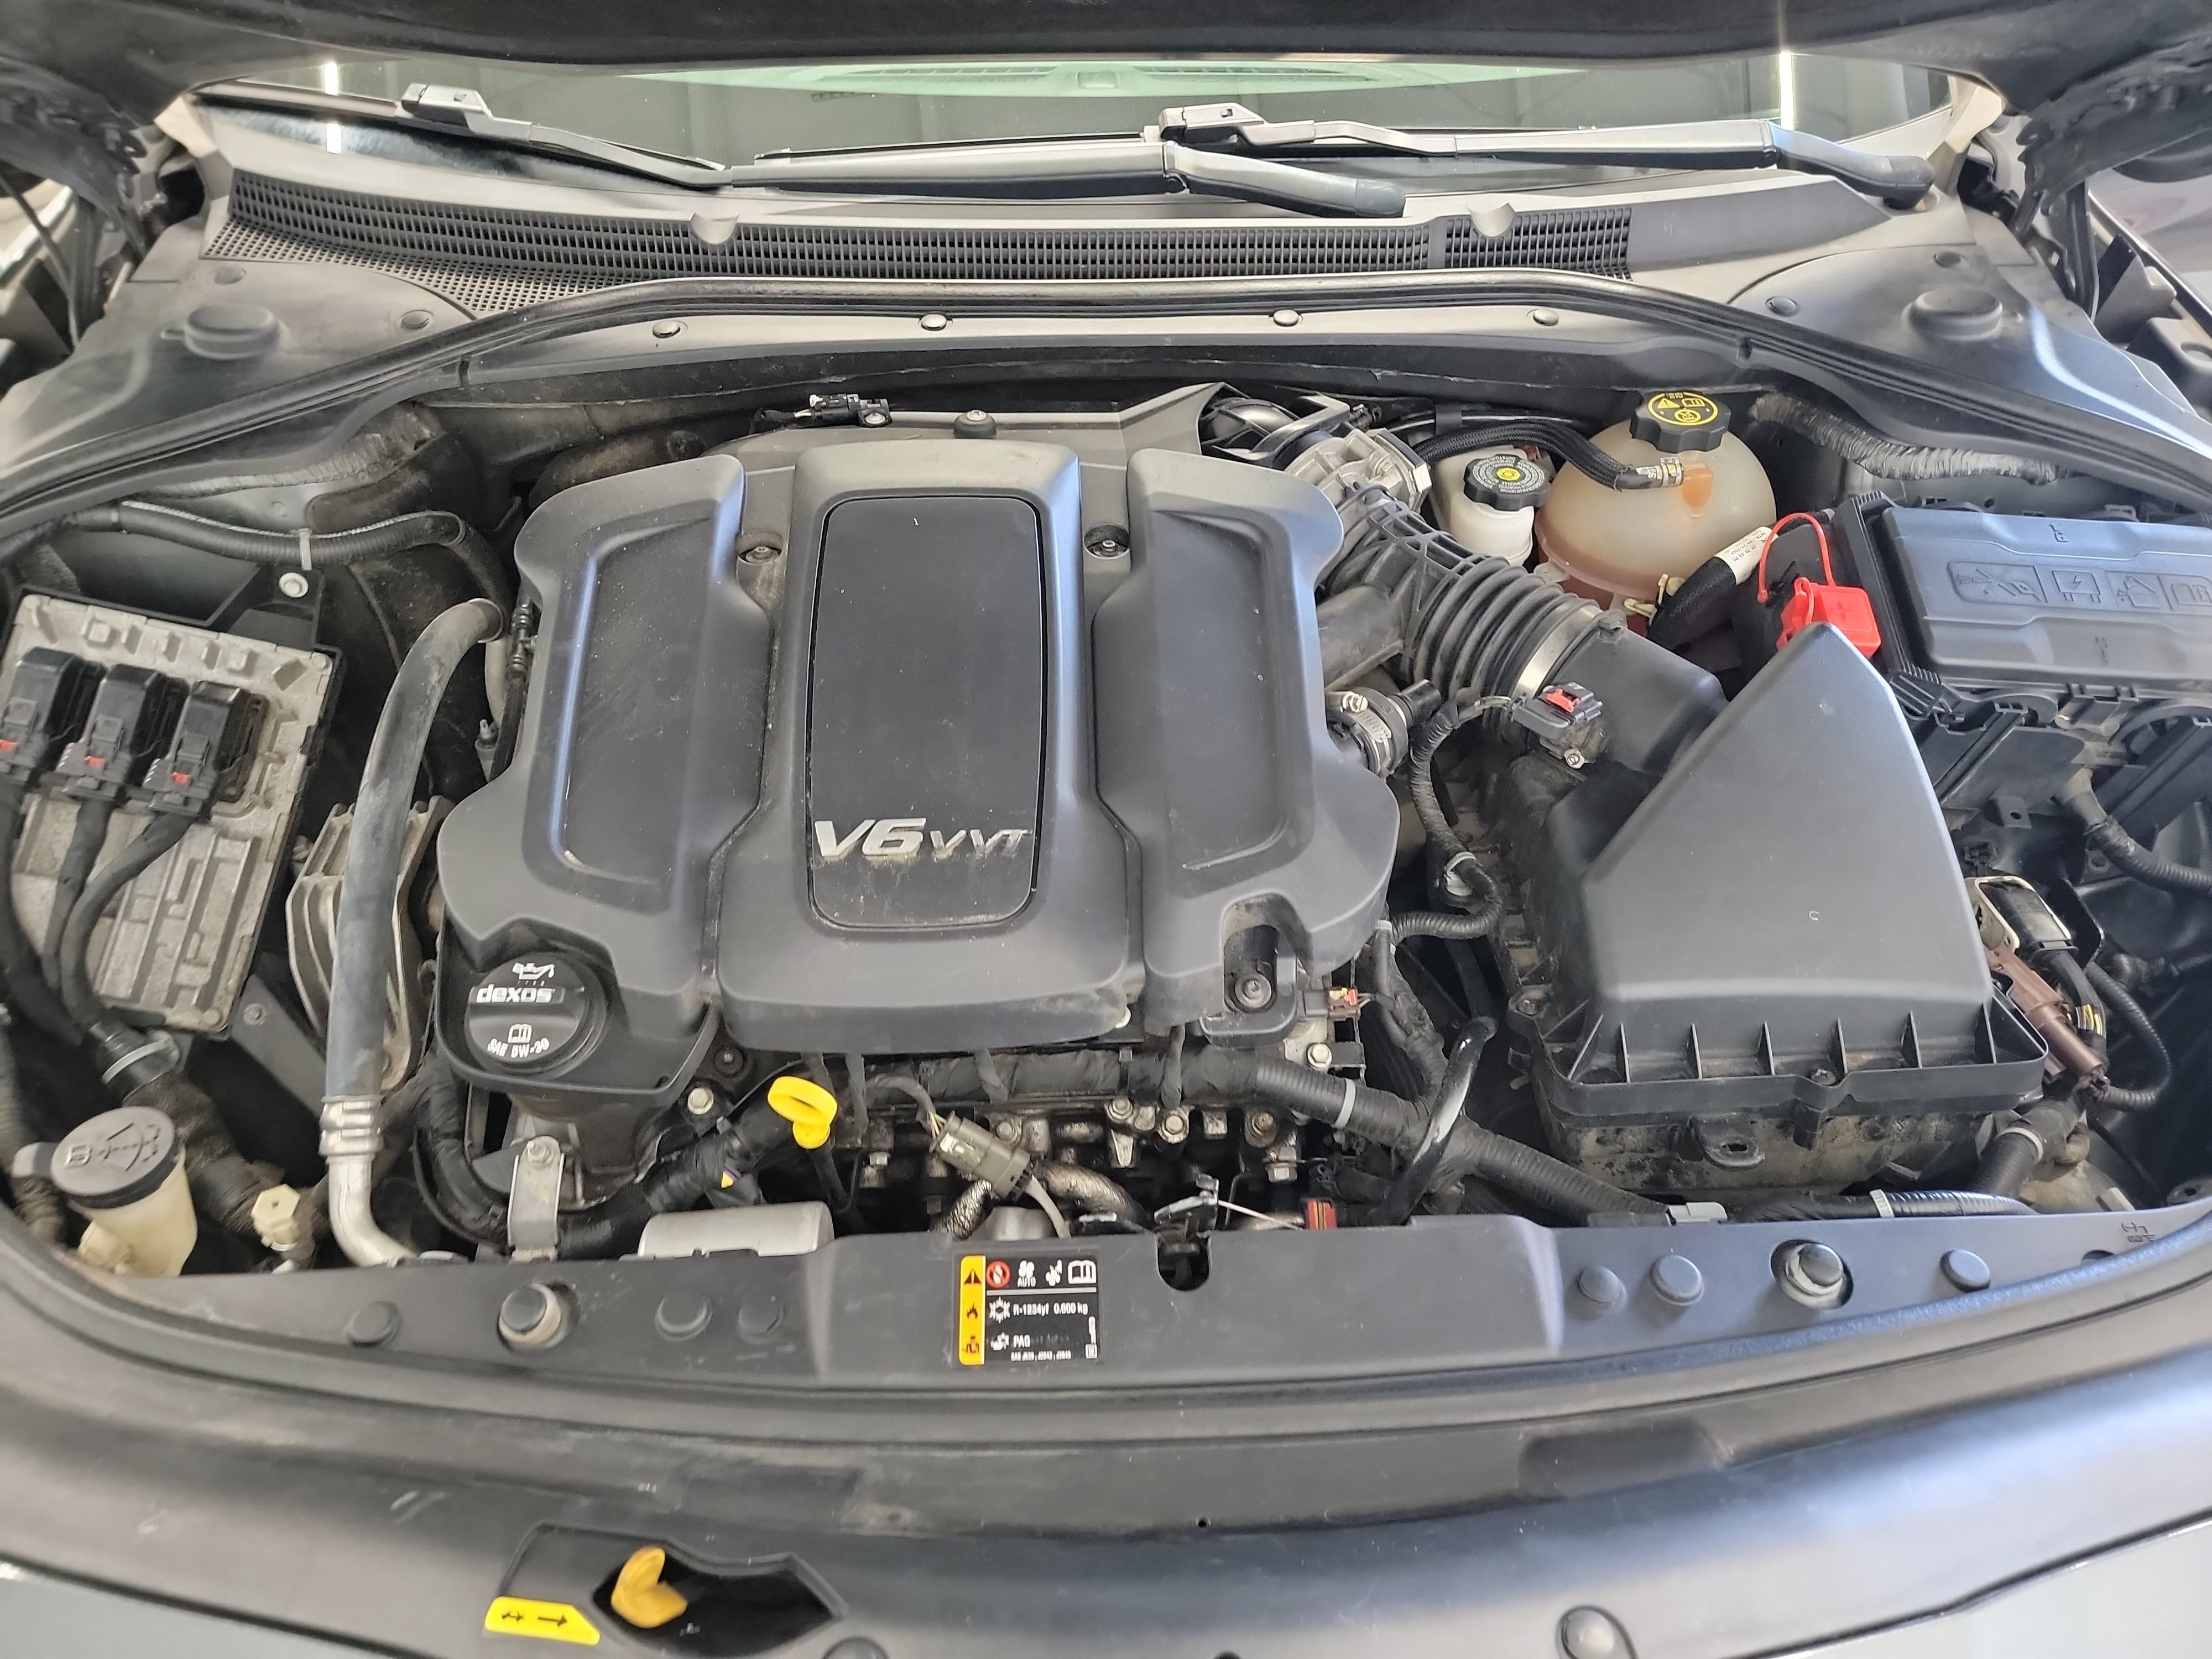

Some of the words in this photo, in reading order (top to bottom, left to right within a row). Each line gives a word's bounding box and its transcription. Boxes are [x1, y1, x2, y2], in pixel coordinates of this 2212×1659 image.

[815, 817, 926, 857] V6
[930, 828, 1033, 854] VVT
[476, 984, 556, 1003] dexos
[487, 1038, 509, 1057] SAE
[1017, 1276, 1036, 1287] AUTO
